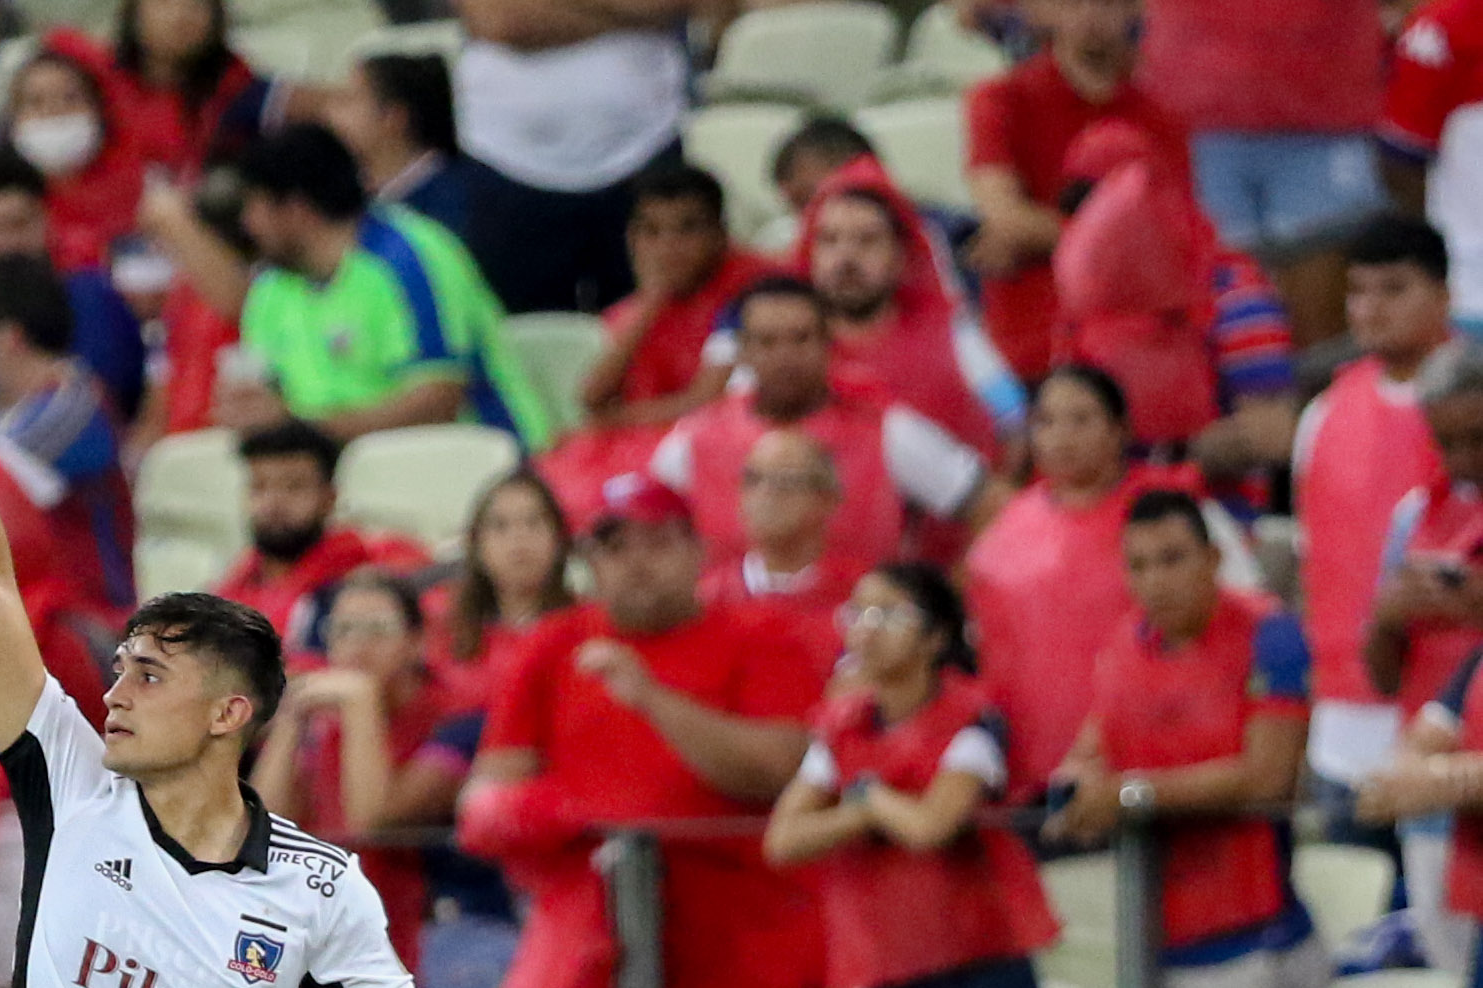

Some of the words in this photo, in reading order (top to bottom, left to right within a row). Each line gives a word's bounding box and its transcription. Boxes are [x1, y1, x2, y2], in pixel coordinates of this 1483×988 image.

[94, 863, 133, 891] adidas
[268, 850, 345, 882] IRECTV
[306, 874, 335, 898] GO
